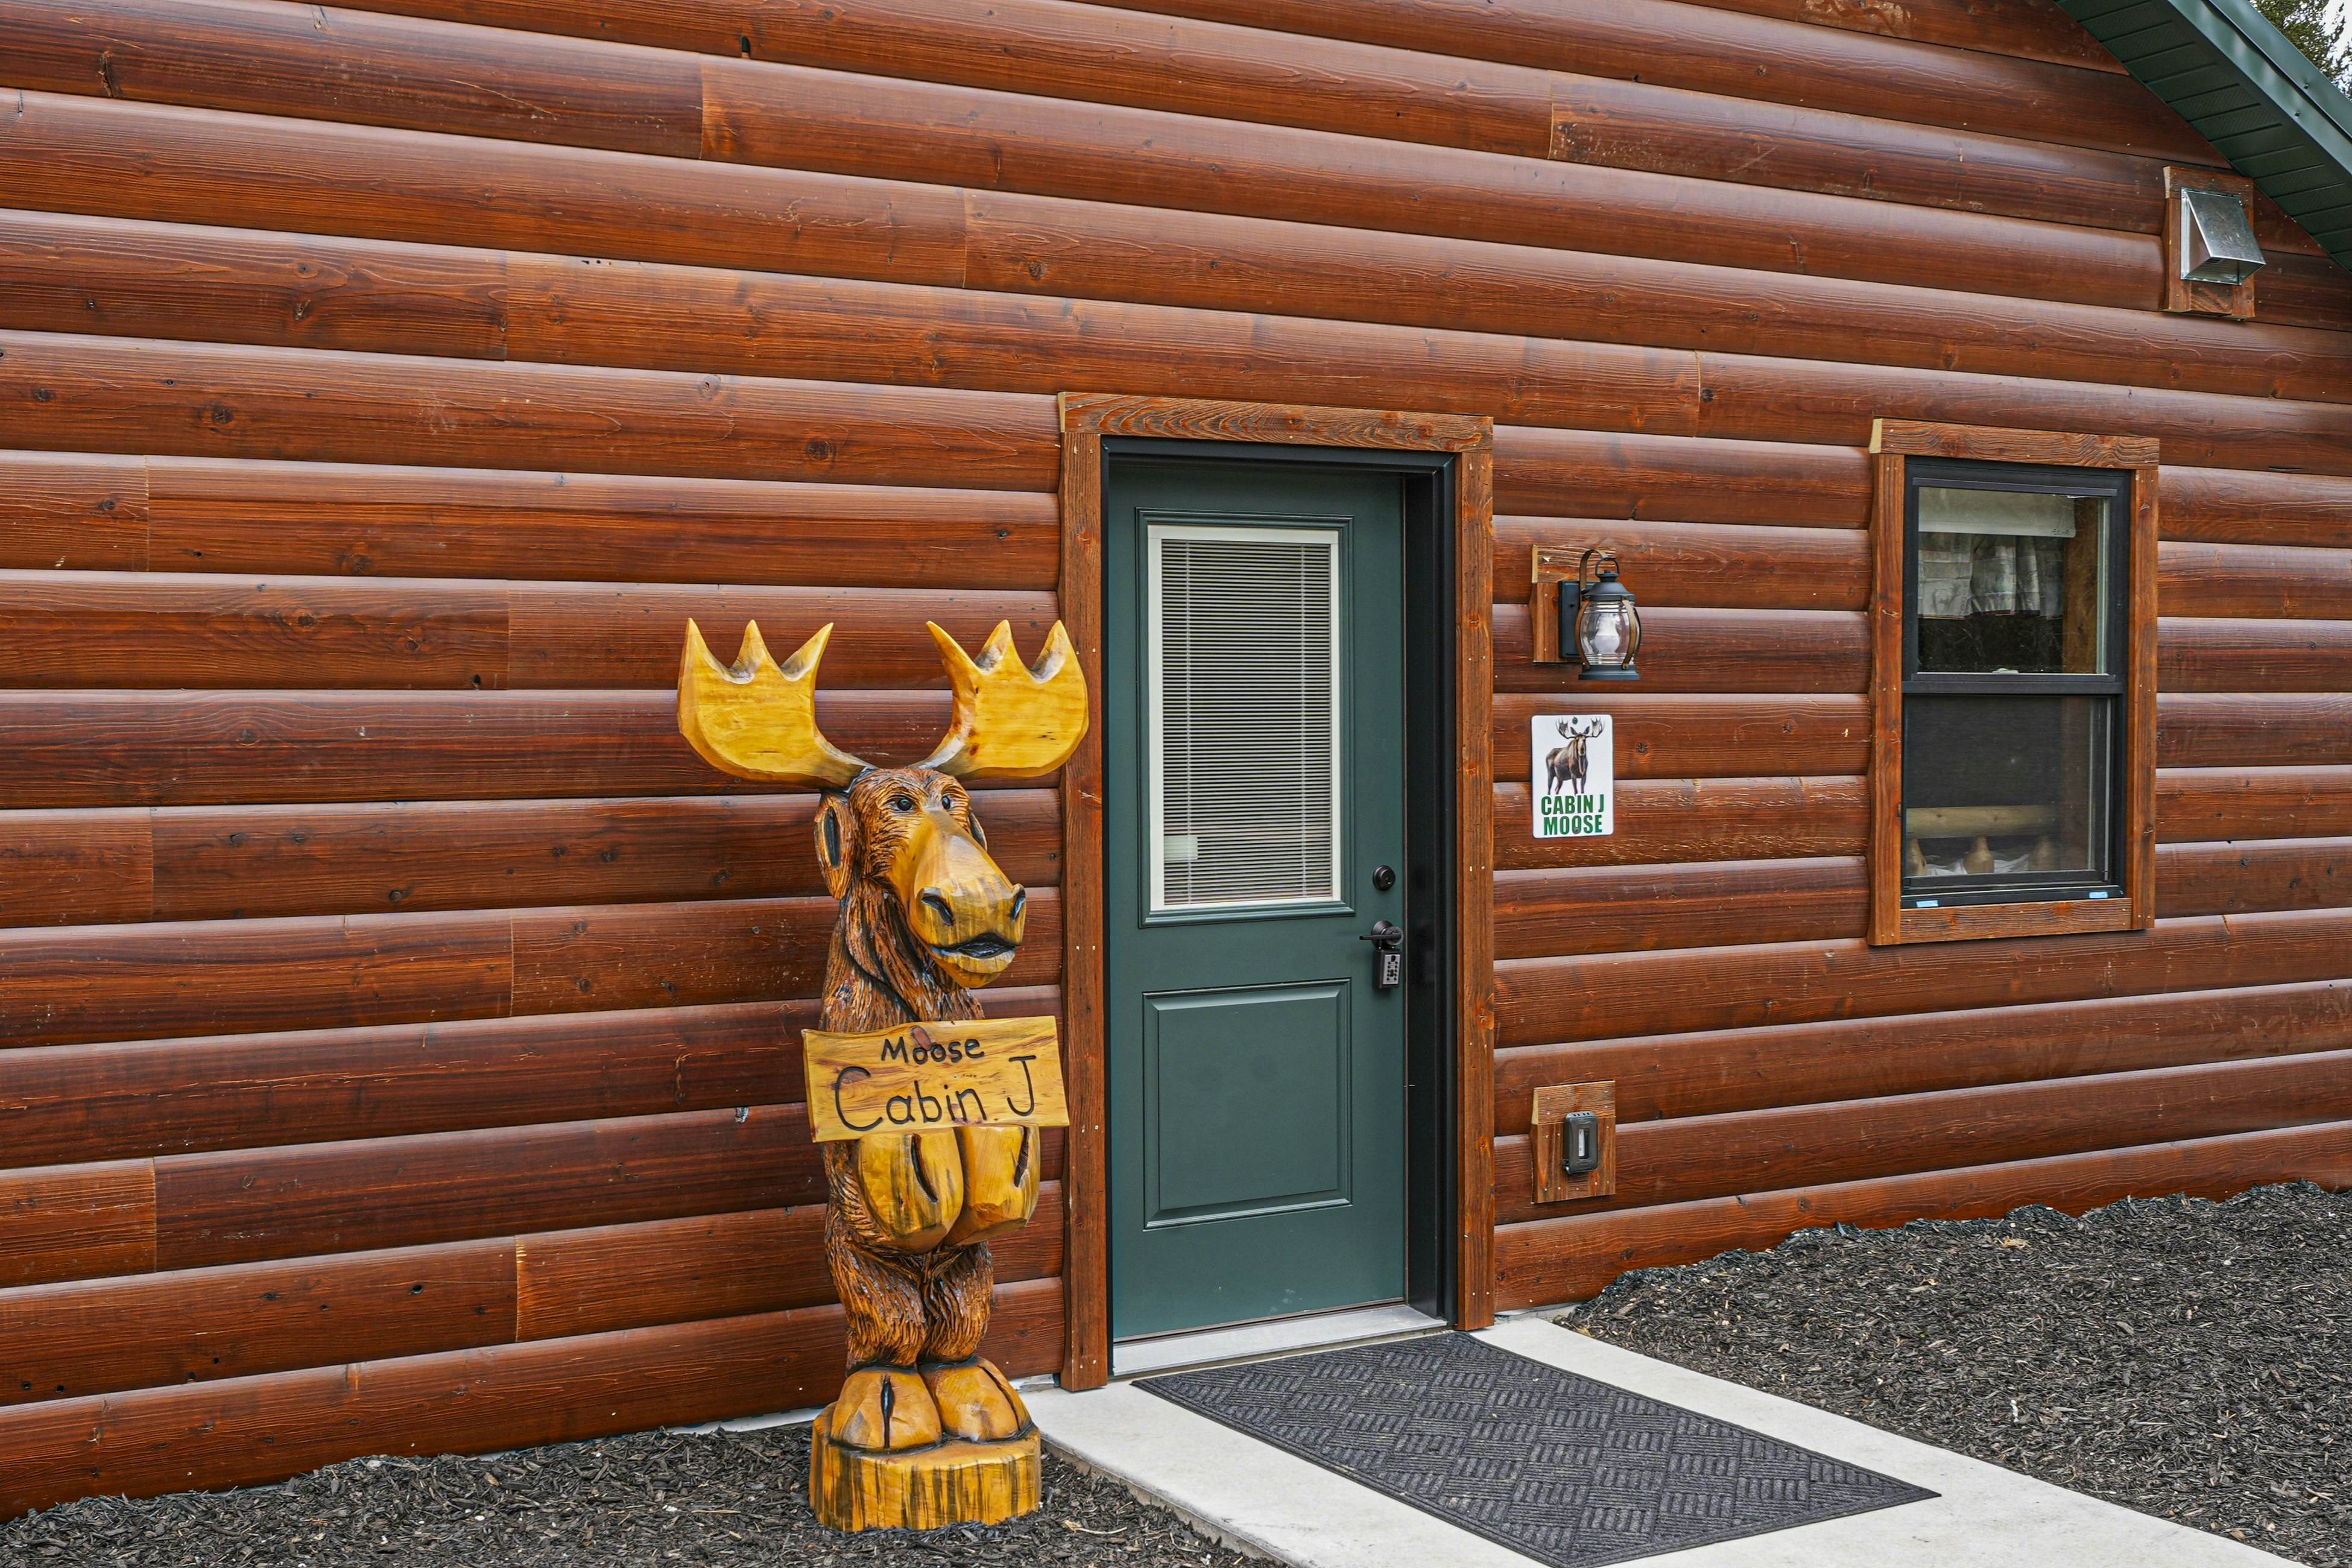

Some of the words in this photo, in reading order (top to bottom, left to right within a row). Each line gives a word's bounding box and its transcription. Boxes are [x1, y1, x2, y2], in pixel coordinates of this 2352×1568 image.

[1541, 794, 1593, 815] CABIN
[1598, 794, 1604, 812] J
[1544, 815, 1602, 835] MOOSE
[881, 1036, 985, 1064] Moose
[834, 1066, 987, 1131] Cabin
[1007, 1055, 1037, 1116] J
